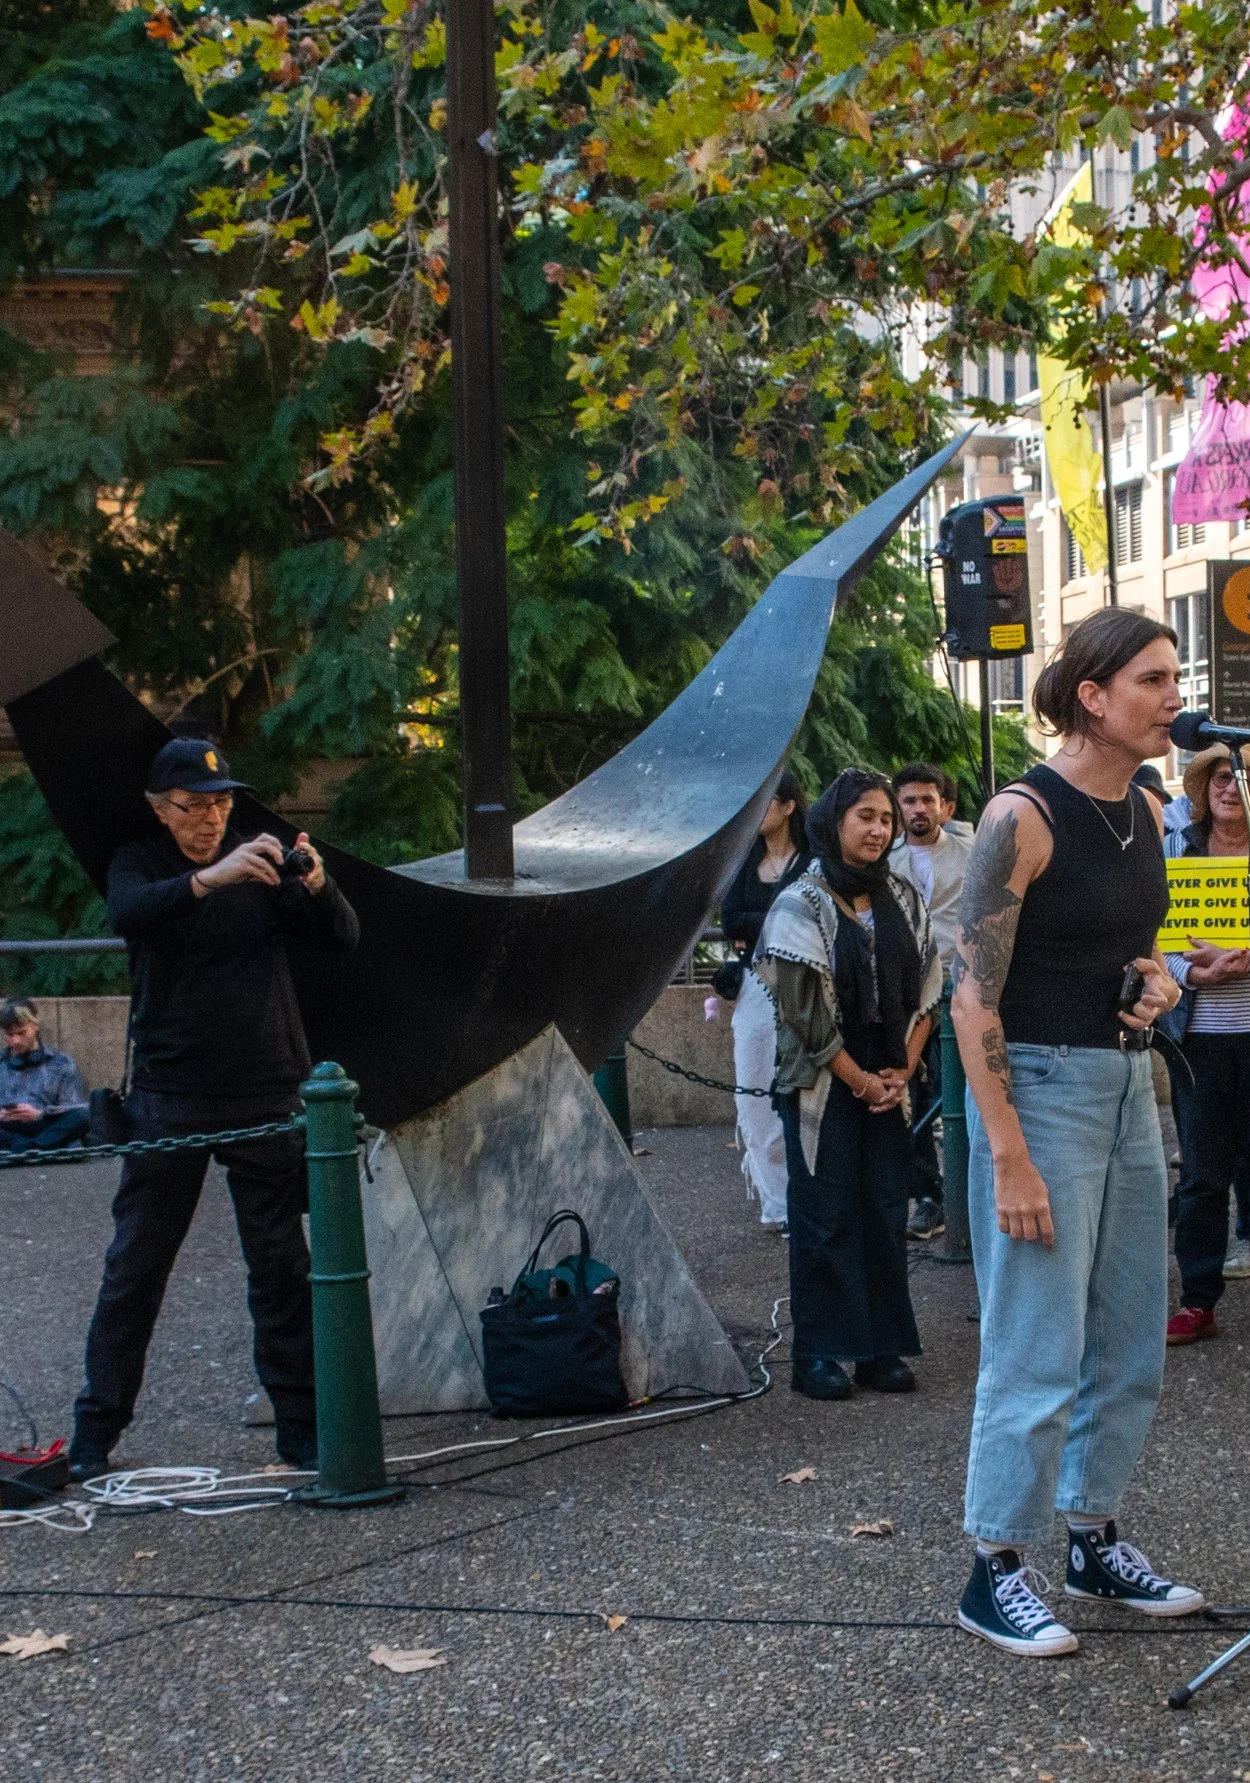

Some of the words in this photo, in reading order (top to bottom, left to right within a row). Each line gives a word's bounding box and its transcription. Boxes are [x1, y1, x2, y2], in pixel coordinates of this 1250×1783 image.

[962, 560, 976, 573] NO
[961, 573, 981, 585] WAR
[1167, 878, 1201, 889] EVER
[1205, 877, 1238, 888] GIVE
[1168, 898, 1200, 909] EVER
[1204, 897, 1238, 908] GIVE
[1203, 917, 1236, 928] GIVE
